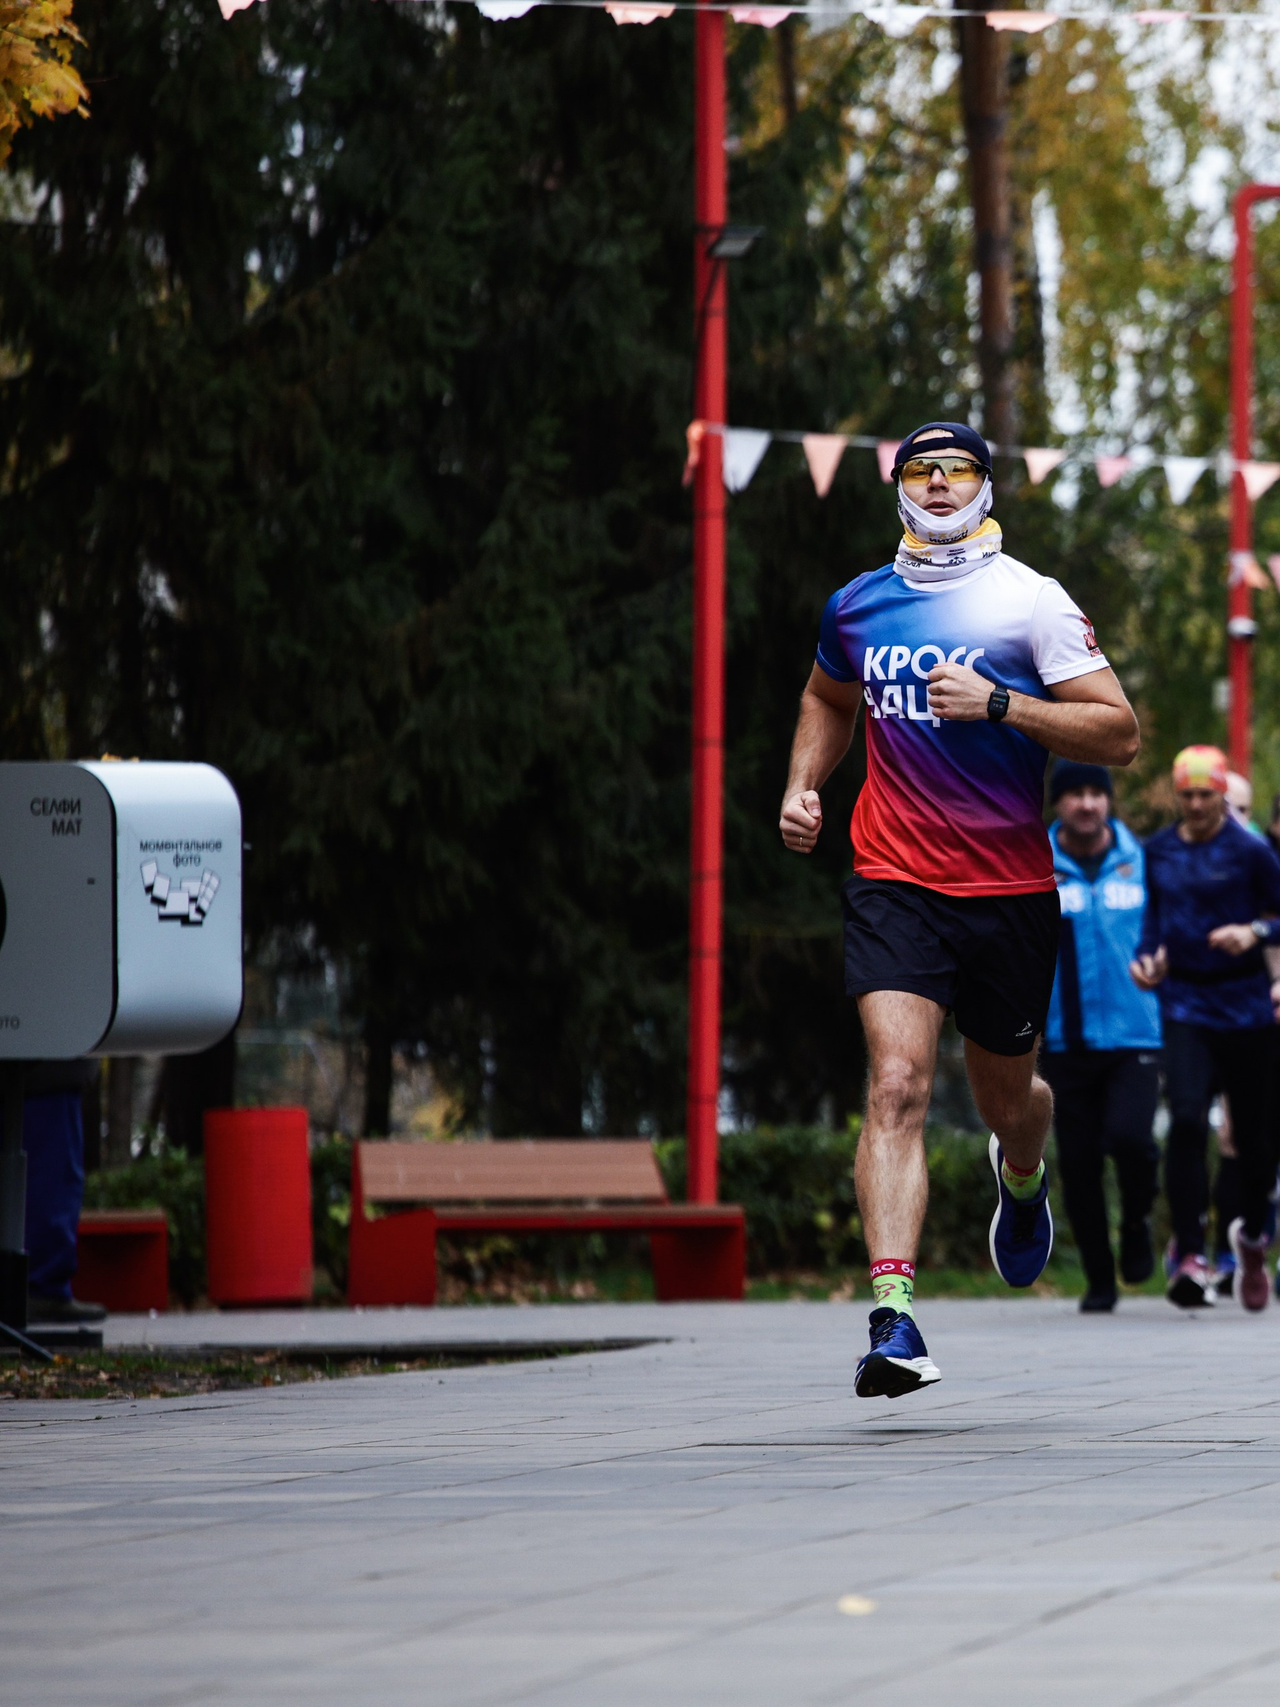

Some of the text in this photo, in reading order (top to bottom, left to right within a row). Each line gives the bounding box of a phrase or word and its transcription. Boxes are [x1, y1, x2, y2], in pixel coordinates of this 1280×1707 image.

[30, 797, 81, 816] СЕЛФИ
[52, 818, 82, 837] МАТ
[173, 852, 201, 869] фото
[870, 1263, 895, 1276] до
